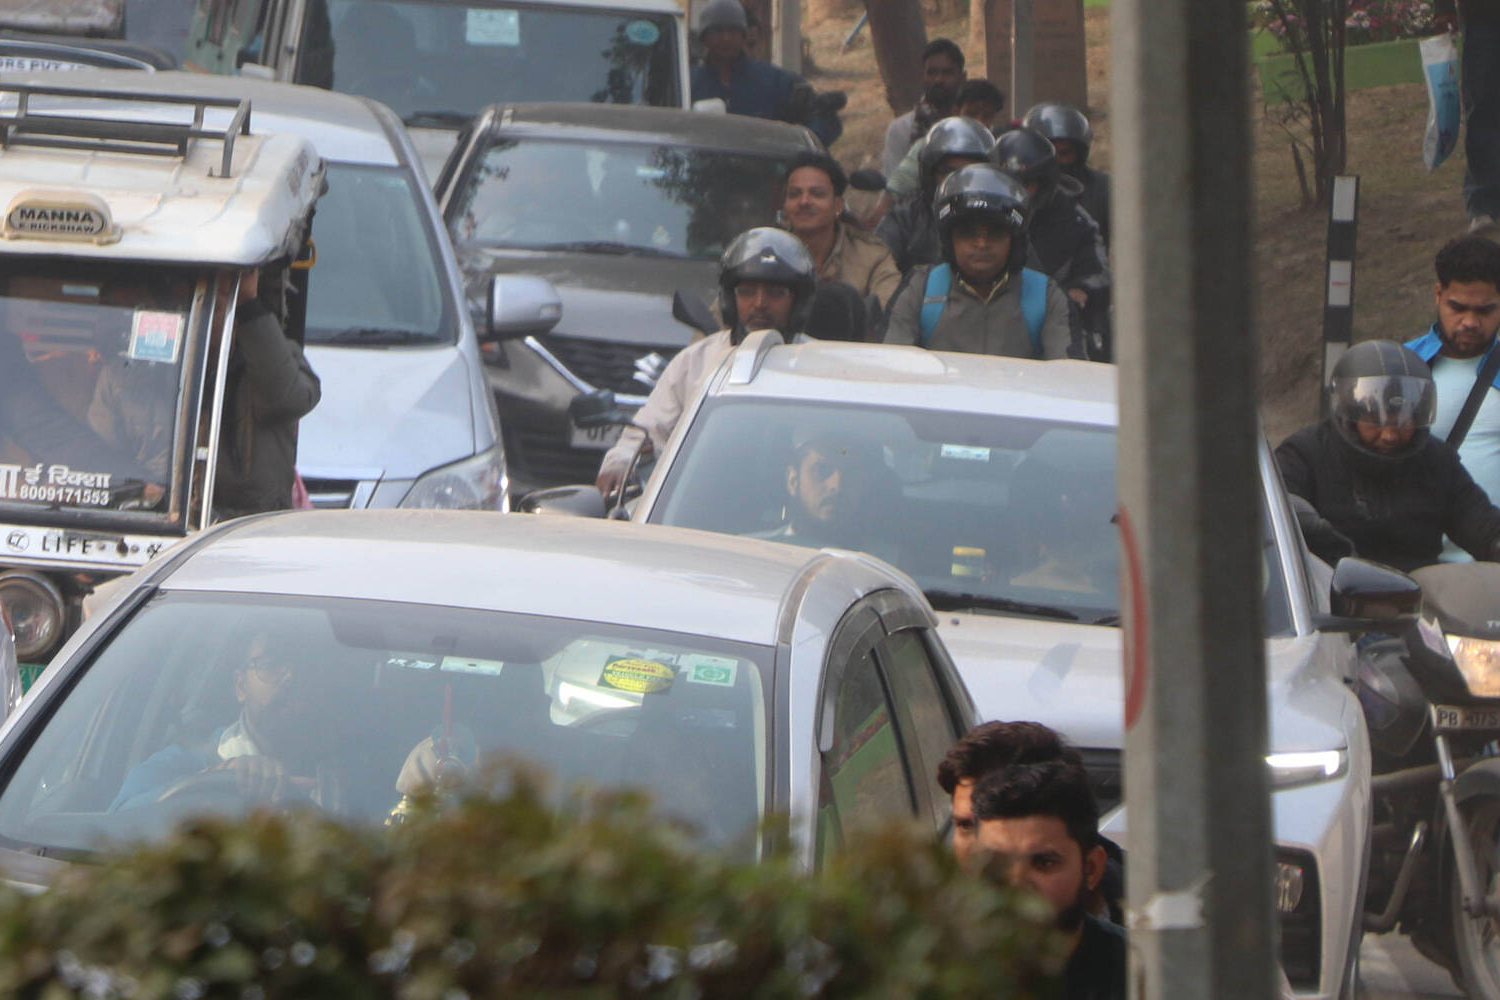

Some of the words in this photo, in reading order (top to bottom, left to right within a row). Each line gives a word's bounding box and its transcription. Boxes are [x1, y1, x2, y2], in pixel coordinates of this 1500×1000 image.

[20, 208, 94, 223] MANNA
[25, 462, 43, 485] ई
[48, 464, 112, 489] रिक्शा
[42, 535, 94, 554] LIFE
